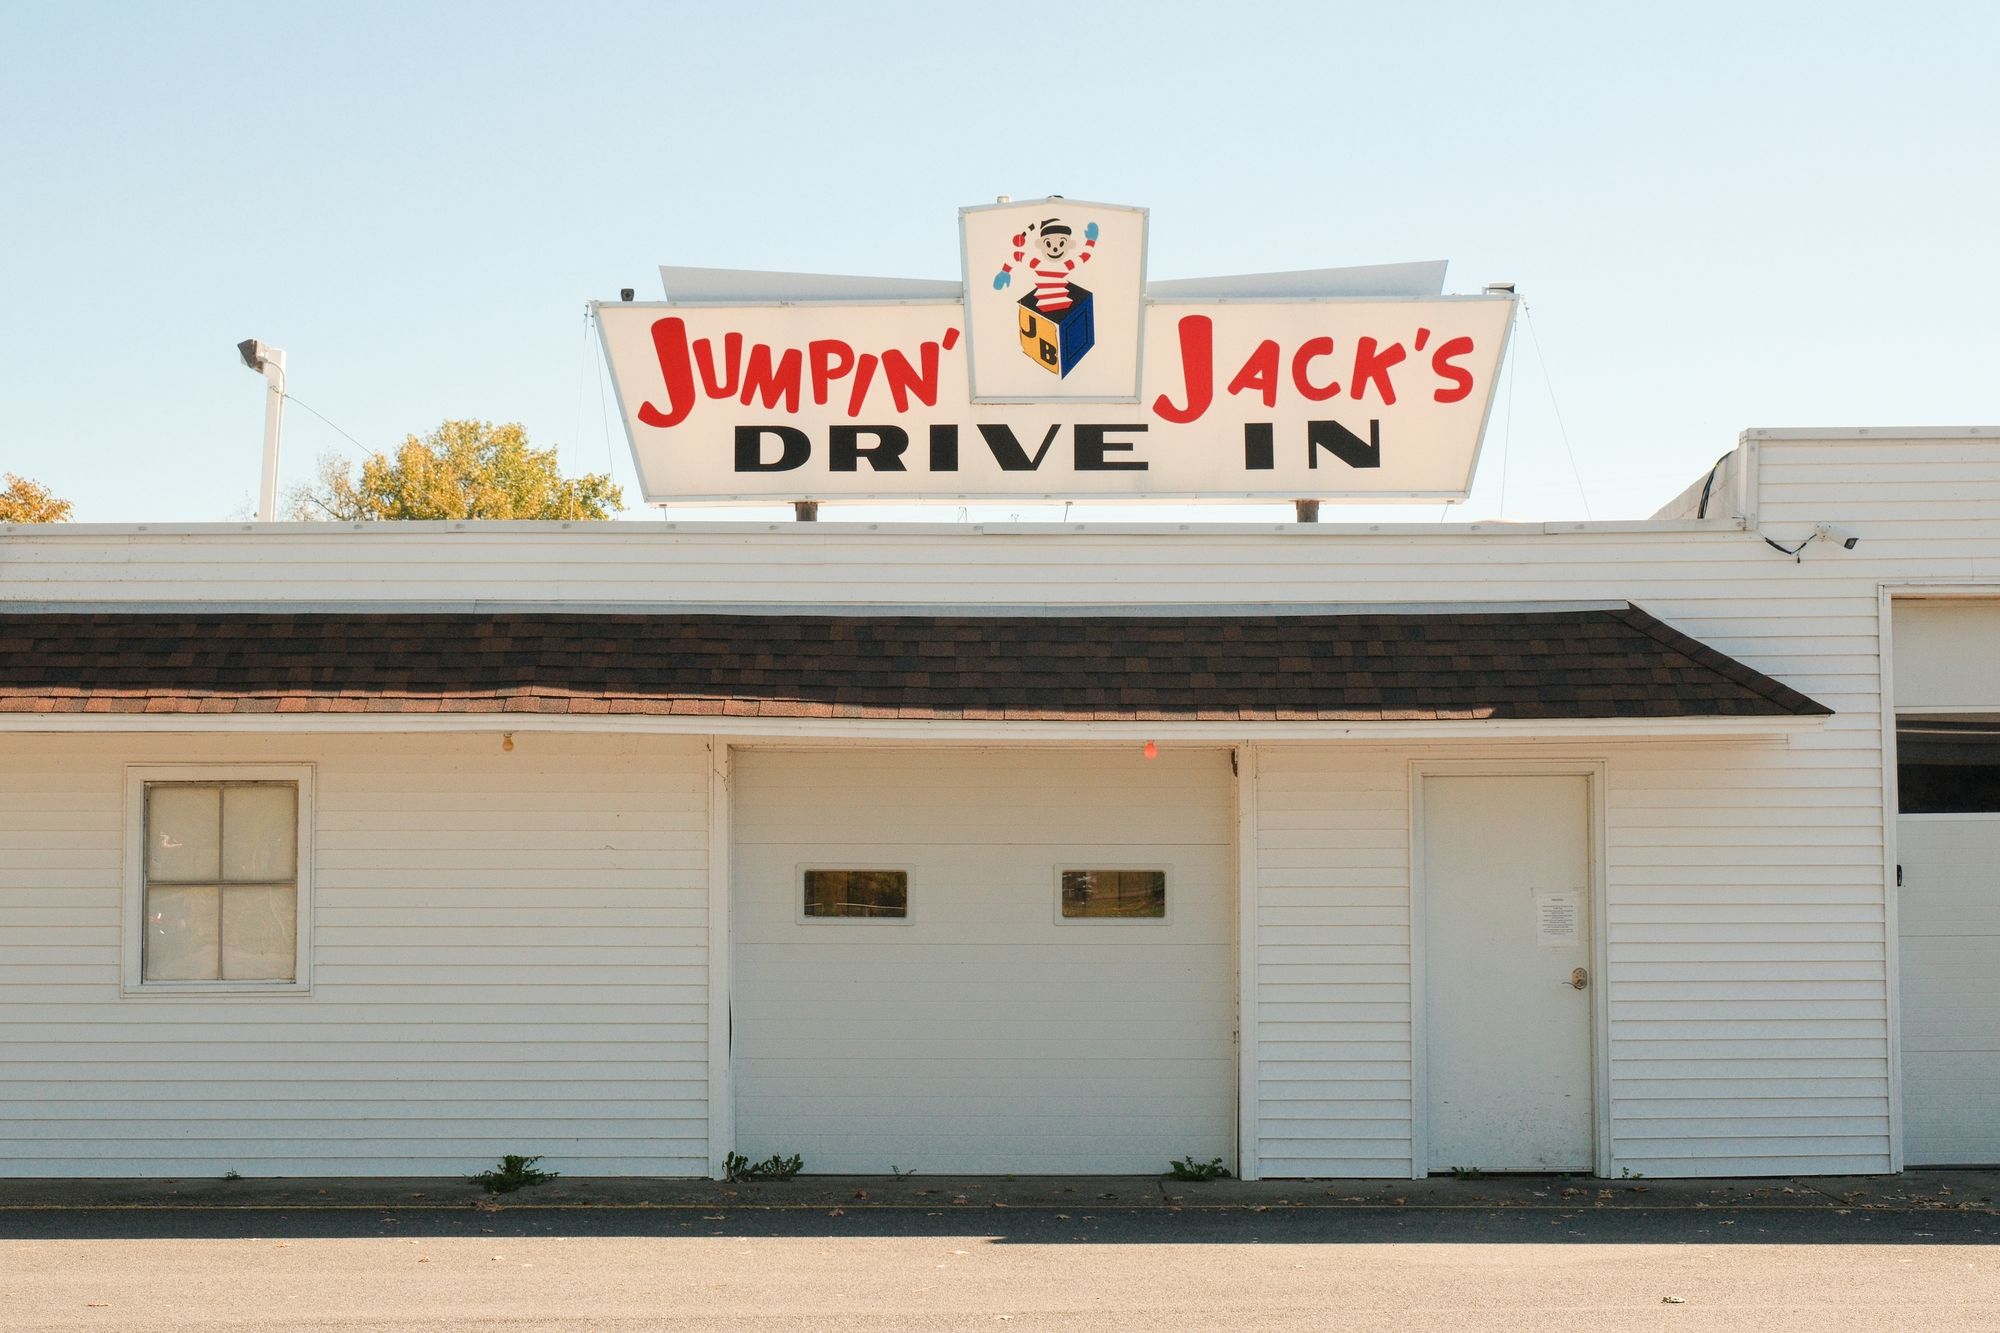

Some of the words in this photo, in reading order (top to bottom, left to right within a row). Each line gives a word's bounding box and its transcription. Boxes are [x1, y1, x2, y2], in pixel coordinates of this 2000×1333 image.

[637, 316, 961, 429] JUMPIN'
[1152, 314, 1475, 424] JACK'S
[734, 423, 1149, 472] DRIVE
[1244, 419, 1381, 470] IN
